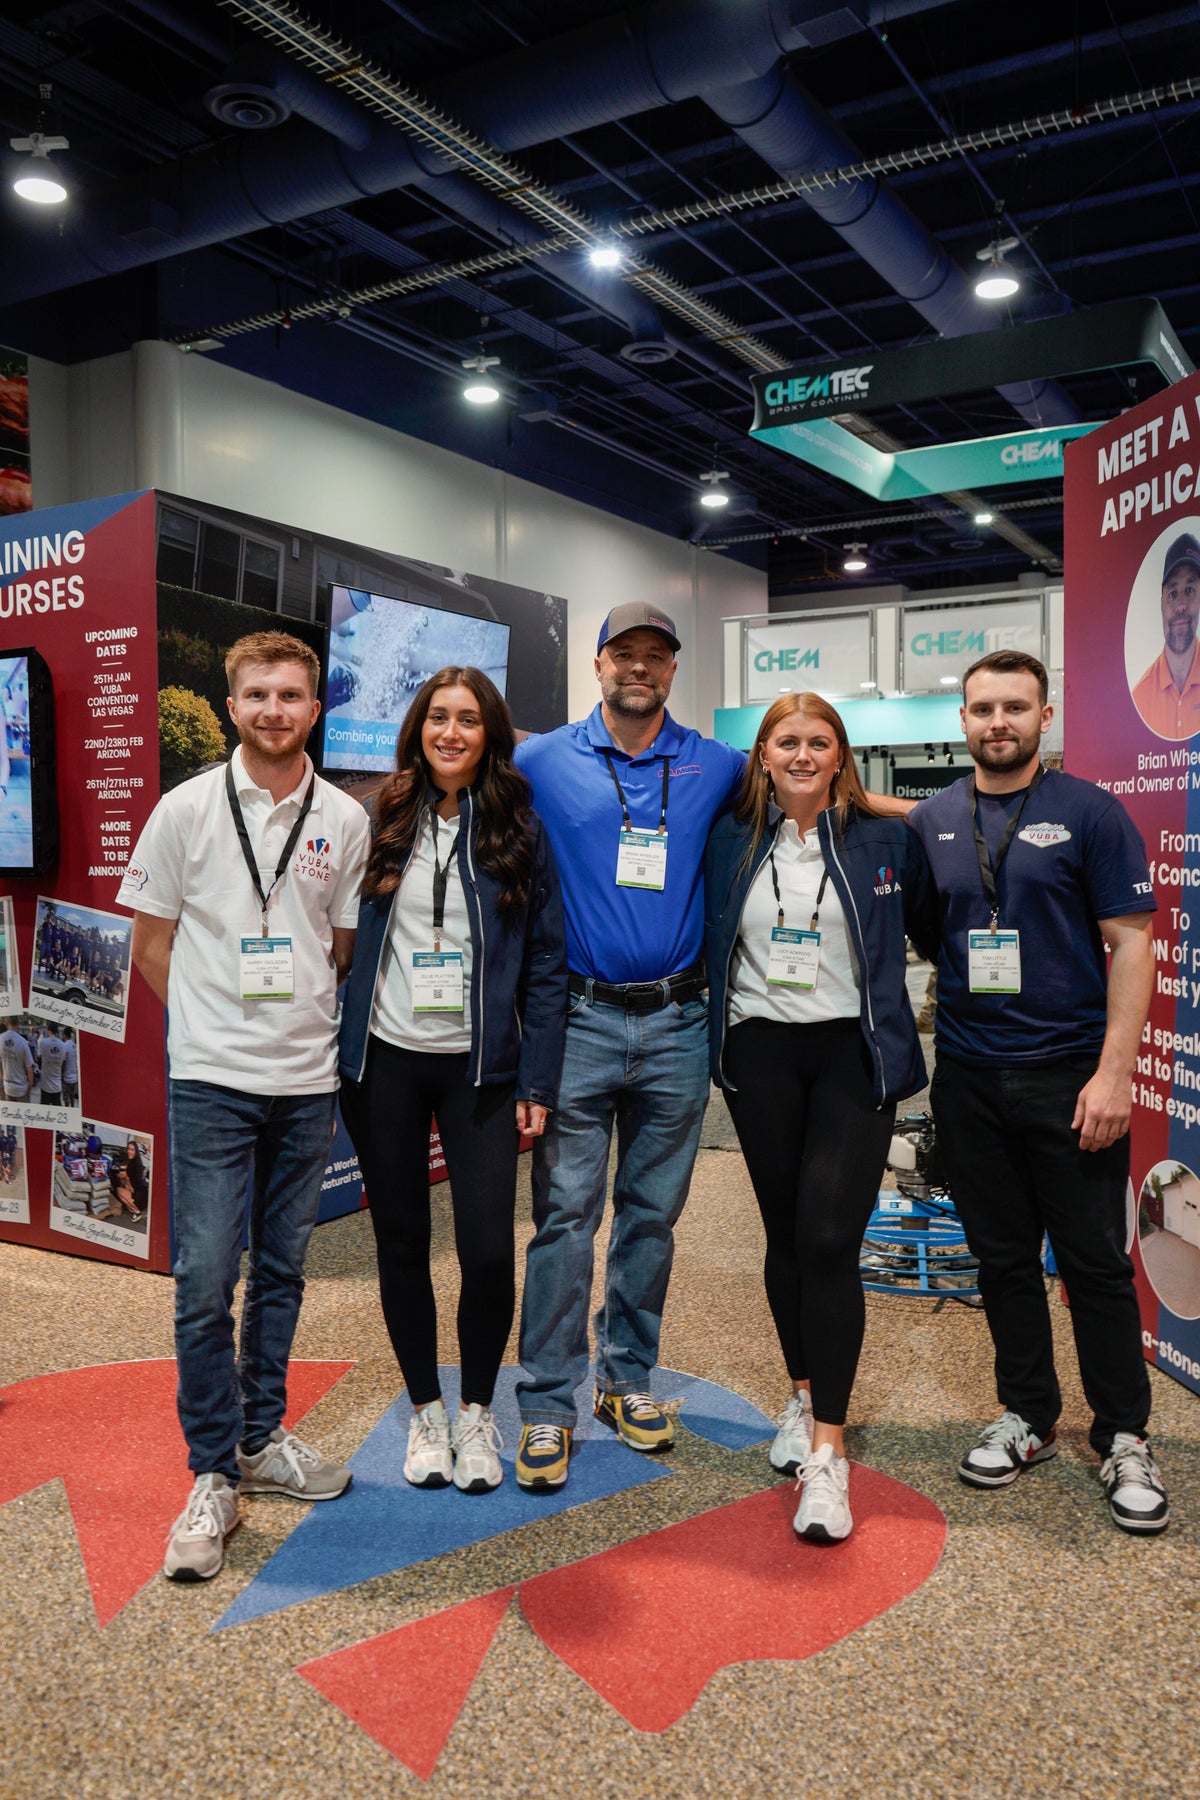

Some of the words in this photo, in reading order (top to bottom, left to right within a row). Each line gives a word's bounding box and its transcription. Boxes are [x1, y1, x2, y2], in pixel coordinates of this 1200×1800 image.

[765, 365, 874, 407] CHEMTEC
[769, 403, 805, 415] EPOXY
[811, 392, 868, 408] COATINGS
[1098, 415, 1164, 485] MEET
[1168, 404, 1190, 450] A
[85, 626, 138, 643] UPCOMING
[96, 644, 127, 658] DATES
[754, 648, 819, 672] CHEM
[94, 674, 113, 684] 25TH
[115, 672, 131, 682] JAN
[100, 684, 122, 694] VUBA
[87, 694, 138, 707] CONVENTION
[92, 708, 106, 717] LAS
[107, 706, 134, 716] VEGAS
[85, 736, 128, 749] 22ND/23RD
[129, 736, 143, 746] FEB
[328, 727, 374, 744] Combine
[97, 748, 131, 759] ARIZONA
[1138, 752, 1167, 770] Brian
[86, 776, 128, 789] 26TH/27TH
[129, 778, 143, 787] FEB
[1113, 776, 1135, 794] and
[1137, 776, 1174, 793] Owner
[1177, 771, 1190, 790] of
[98, 789, 132, 800] ARIZONA
[100, 821, 132, 831] +MORE
[101, 836, 130, 846] DATES
[938, 833, 955, 841] TOM
[1160, 830, 1200, 852] From
[103, 851, 116, 861] TO
[117, 851, 129, 861] BE
[299, 853, 329, 870] VUBA
[295, 863, 331, 881] STONE
[873, 882, 902, 896] VUBA
[1170, 907, 1191, 931] To
[1172, 940, 1188, 964] of
[1157, 970, 1188, 998] last
[110, 1019, 123, 1033] 23
[1155, 1057, 1171, 1081] to
[1140, 1083, 1163, 1112] his
[56, 1112, 68, 1124] 23
[9, 1202, 20, 1213] 23
[122, 1234, 135, 1247] 23
